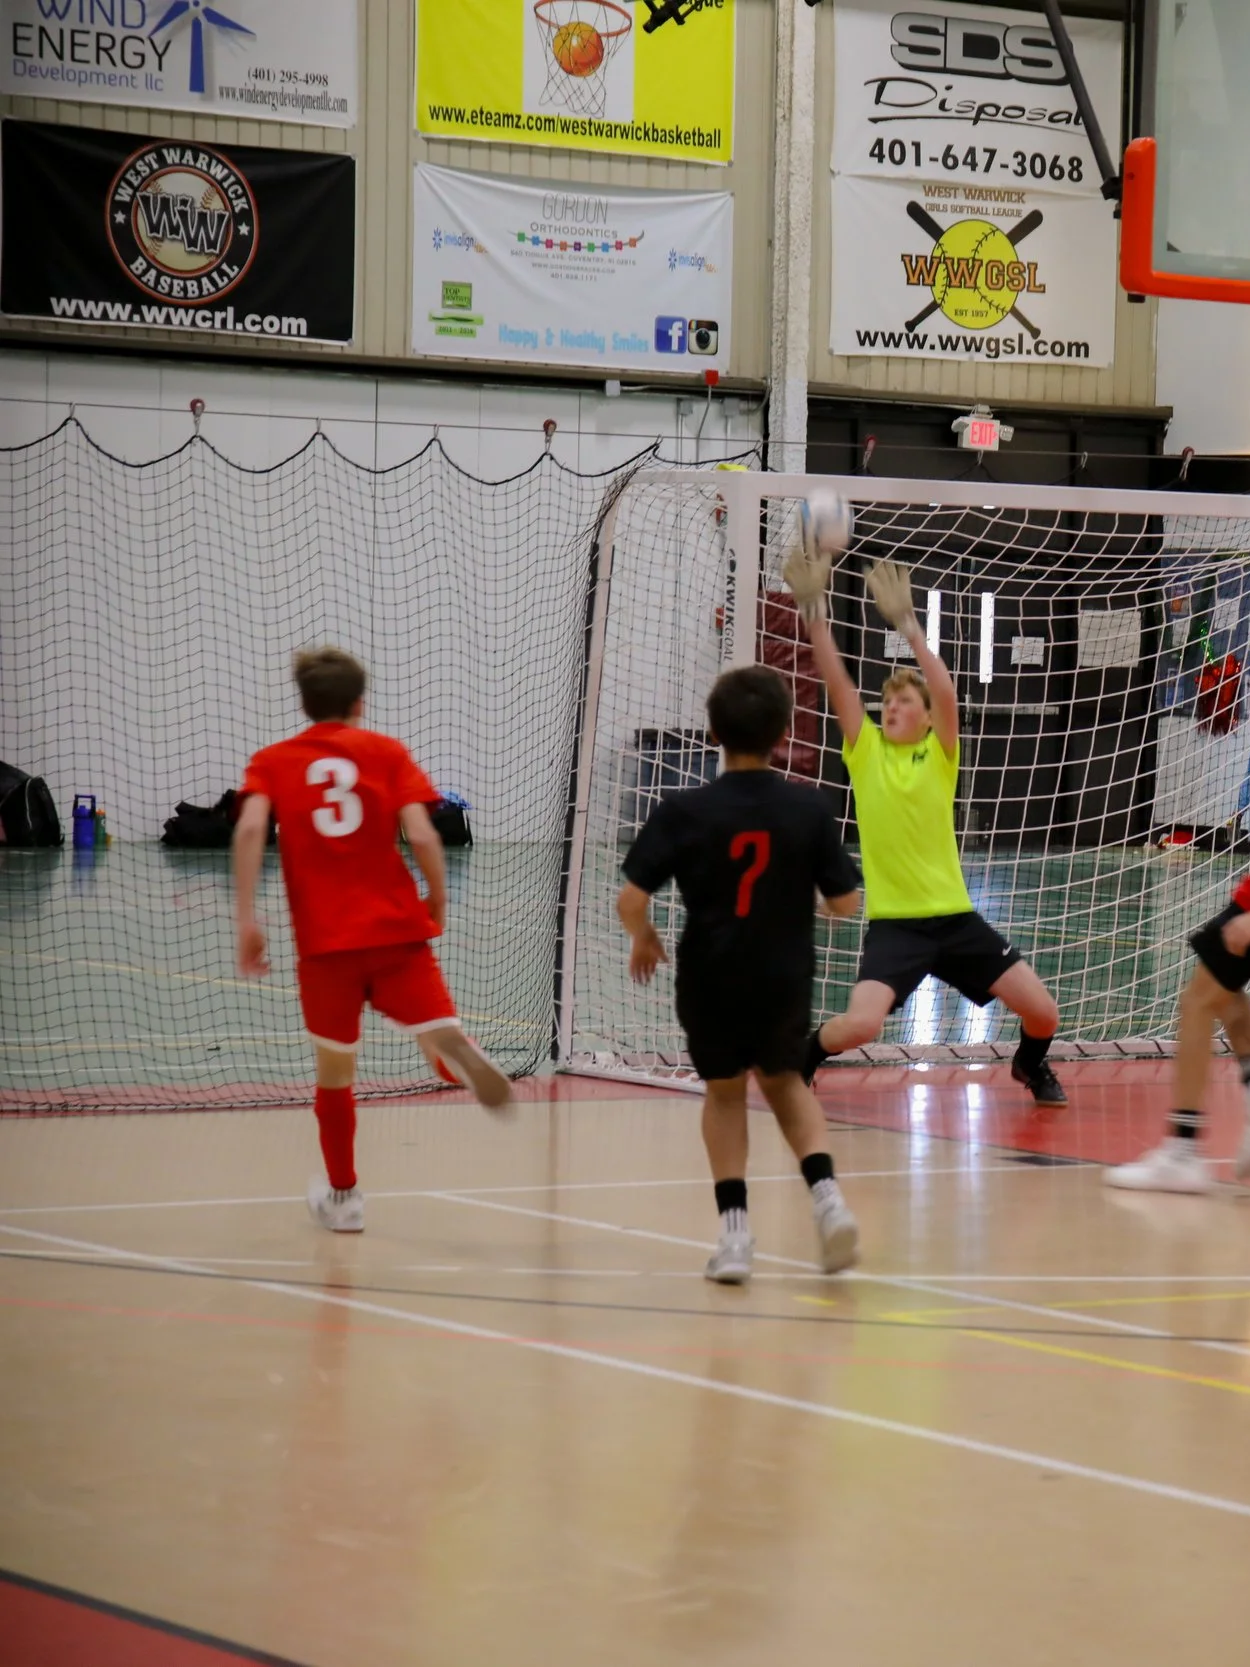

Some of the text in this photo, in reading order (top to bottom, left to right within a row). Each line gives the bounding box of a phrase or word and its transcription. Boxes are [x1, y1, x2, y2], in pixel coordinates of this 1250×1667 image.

[38, 0, 146, 30] WIND
[12, 22, 172, 73] ENERGY
[890, 12, 1071, 86] SDS
[13, 58, 164, 92] Development llc
[248, 67, 329, 87] (401) 295-4998
[218, 82, 348, 114] www.windenergydevelopmentllc.com
[864, 77, 1083, 126] Disposal
[428, 104, 722, 149] www.eteamz.com/westwarwickbasketball
[869, 137, 1084, 183] 401-647-3068
[114, 147, 249, 213] WEST WARWICK
[922, 185, 1026, 204] WEST WARWICK
[542, 192, 609, 225] GORDON
[925, 203, 1023, 218] GIRLS SOFTBALL LEAGUE
[530, 222, 618, 240] ORTHODONTICS
[129, 255, 240, 299] BASEBALL
[901, 254, 1046, 293] WWGSL
[50, 297, 308, 337] www.wwcrl.com
[954, 308, 968, 317] EST
[499, 323, 538, 350] Happy
[560, 328, 606, 354] Healthy
[611, 331, 649, 353] Smiles
[856, 330, 1090, 359] www.wwgsl.com
[970, 420, 995, 446] EXIT
[306, 757, 364, 838] 3
[729, 830, 771, 918] 7
